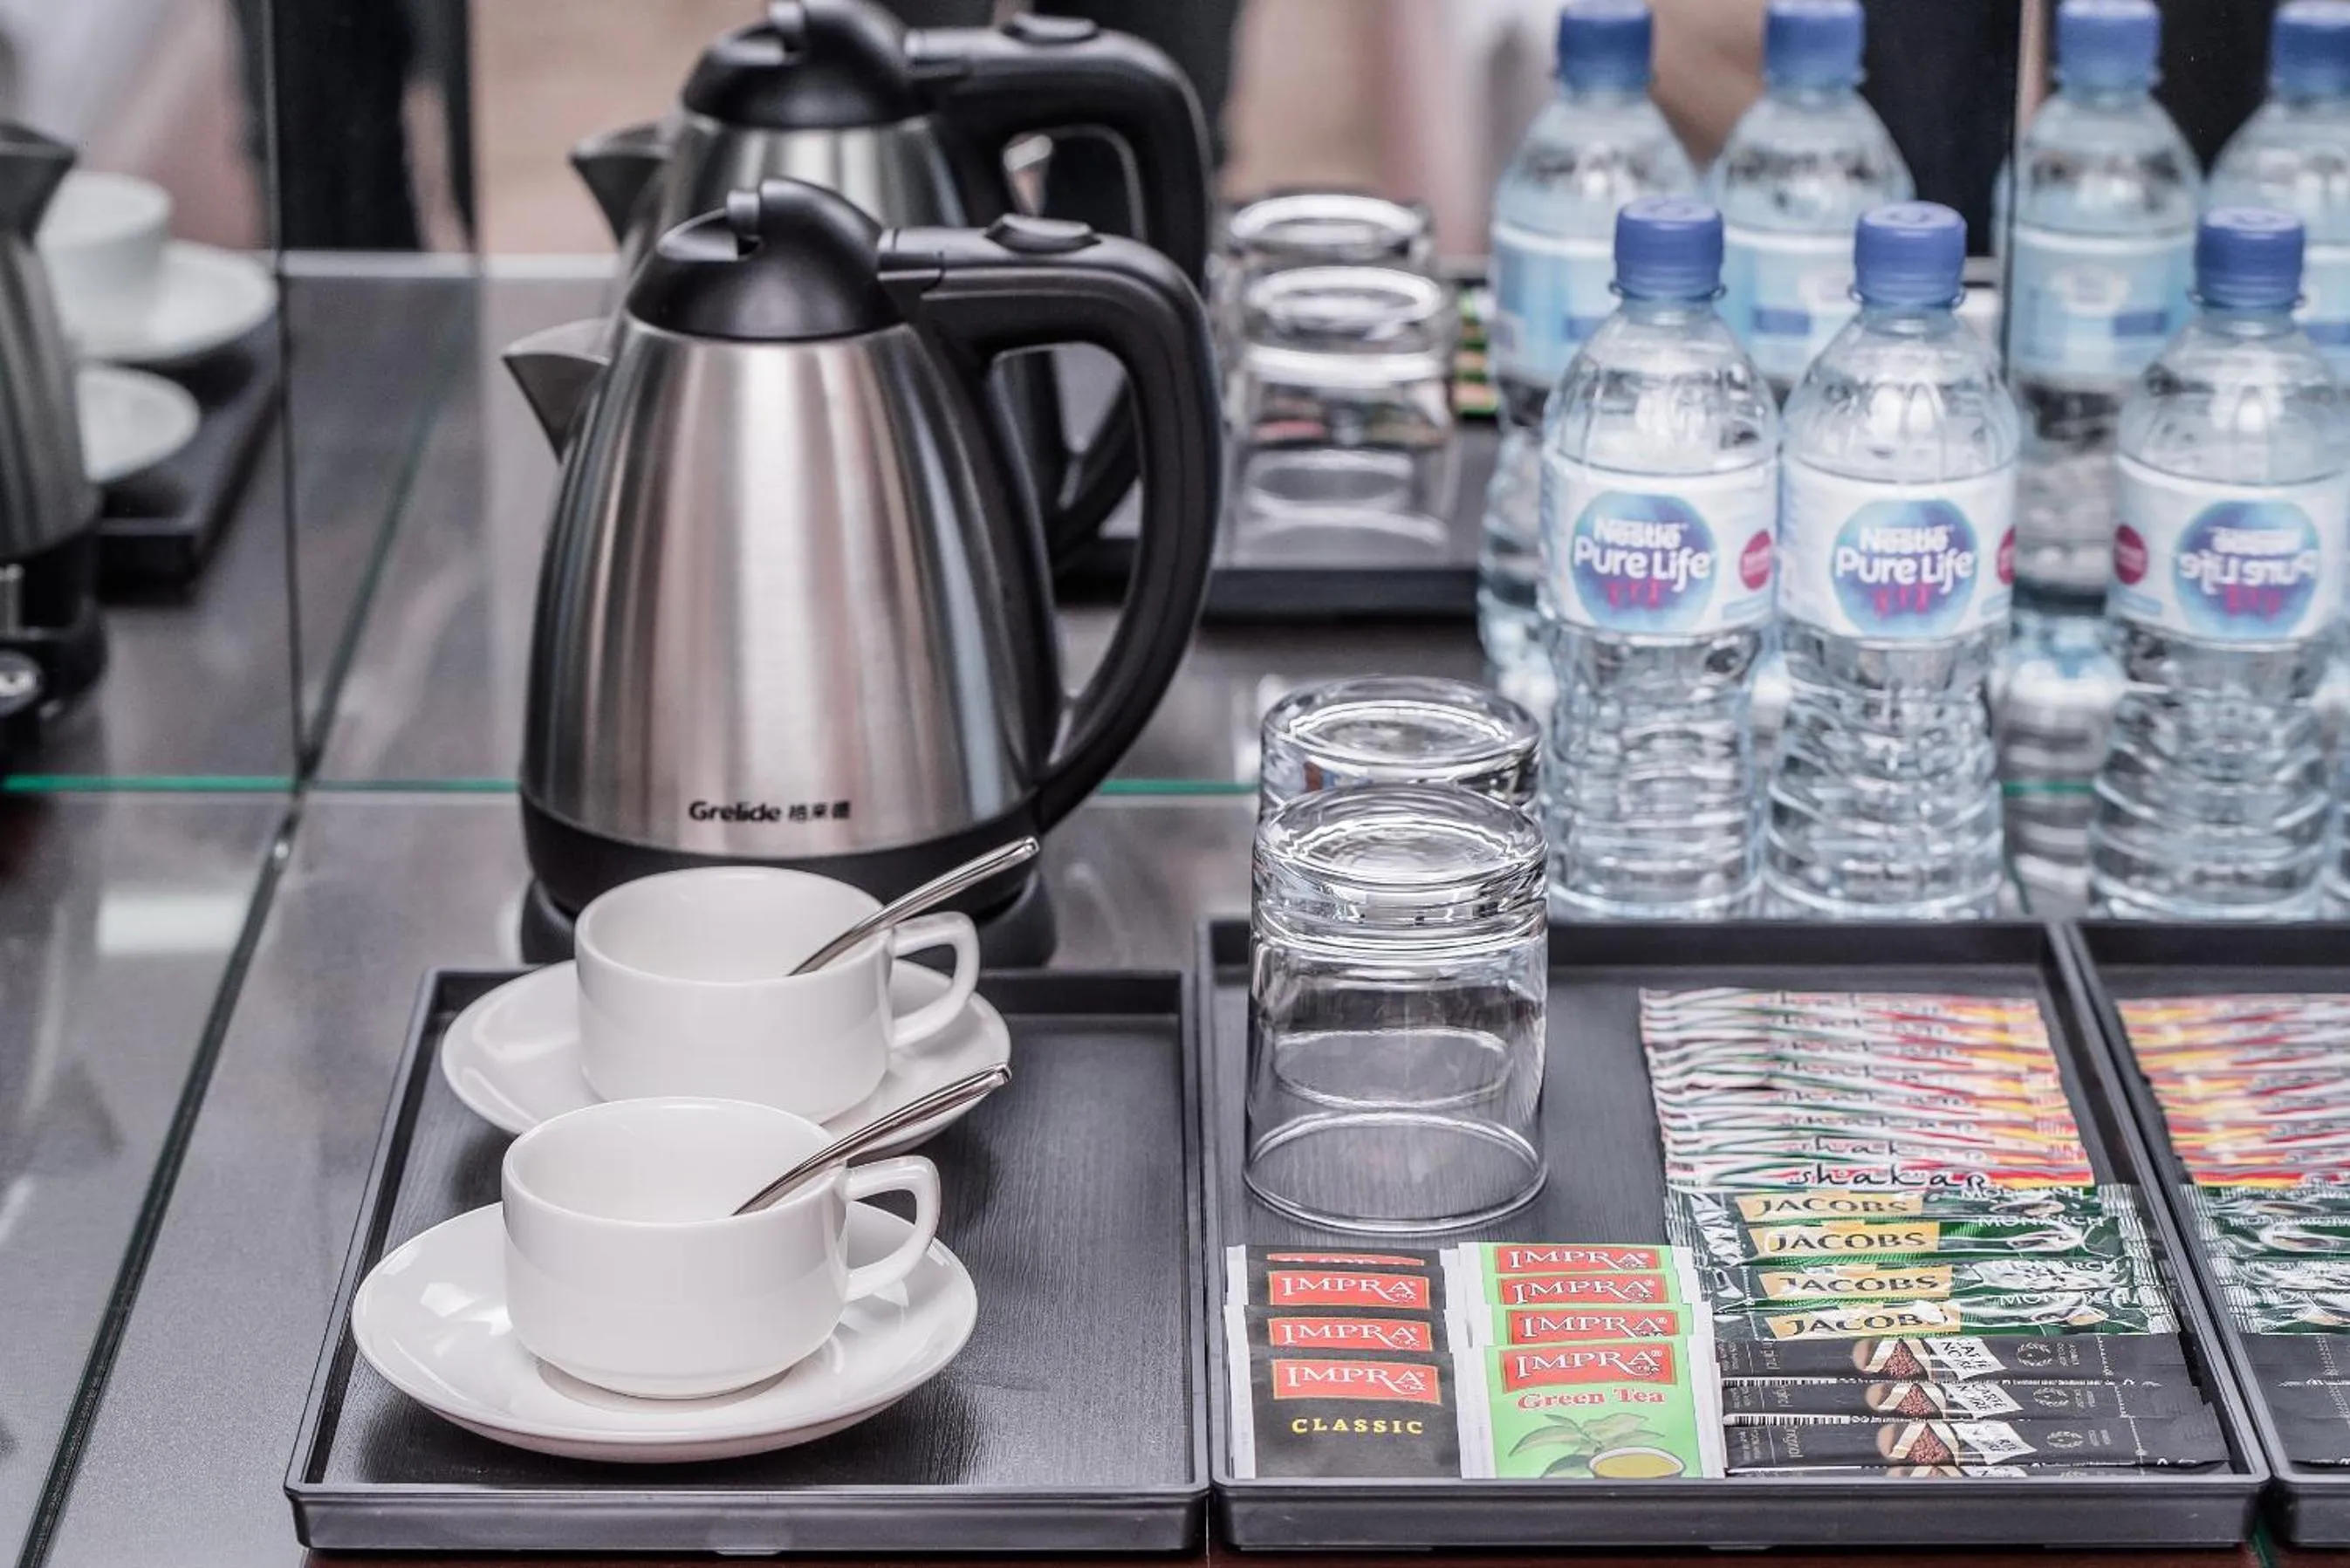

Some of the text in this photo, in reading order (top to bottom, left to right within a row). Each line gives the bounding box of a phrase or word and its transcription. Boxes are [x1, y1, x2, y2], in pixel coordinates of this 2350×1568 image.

[1574, 536, 1648, 579] Pure
[1651, 546, 1710, 592] Life
[1836, 546, 1974, 594] Pure Life
[1754, 1197, 1909, 1216] JACOBS
[1770, 1232, 1927, 1252] JACOBS
[1510, 1250, 1649, 1270] IMPRA
[1282, 1277, 1417, 1303] IMPRA
[1512, 1279, 1655, 1304] IMPRA
[1779, 1275, 1939, 1294] JACOBS
[1281, 1324, 1420, 1349] IMPRA
[1524, 1316, 1668, 1338] IMPRA
[1516, 1350, 1662, 1379] IMPRA
[1285, 1366, 1427, 1395] IMPRA
[1518, 1388, 1667, 1411] Green Tea
[1291, 1418, 1424, 1434] CLASSIC
